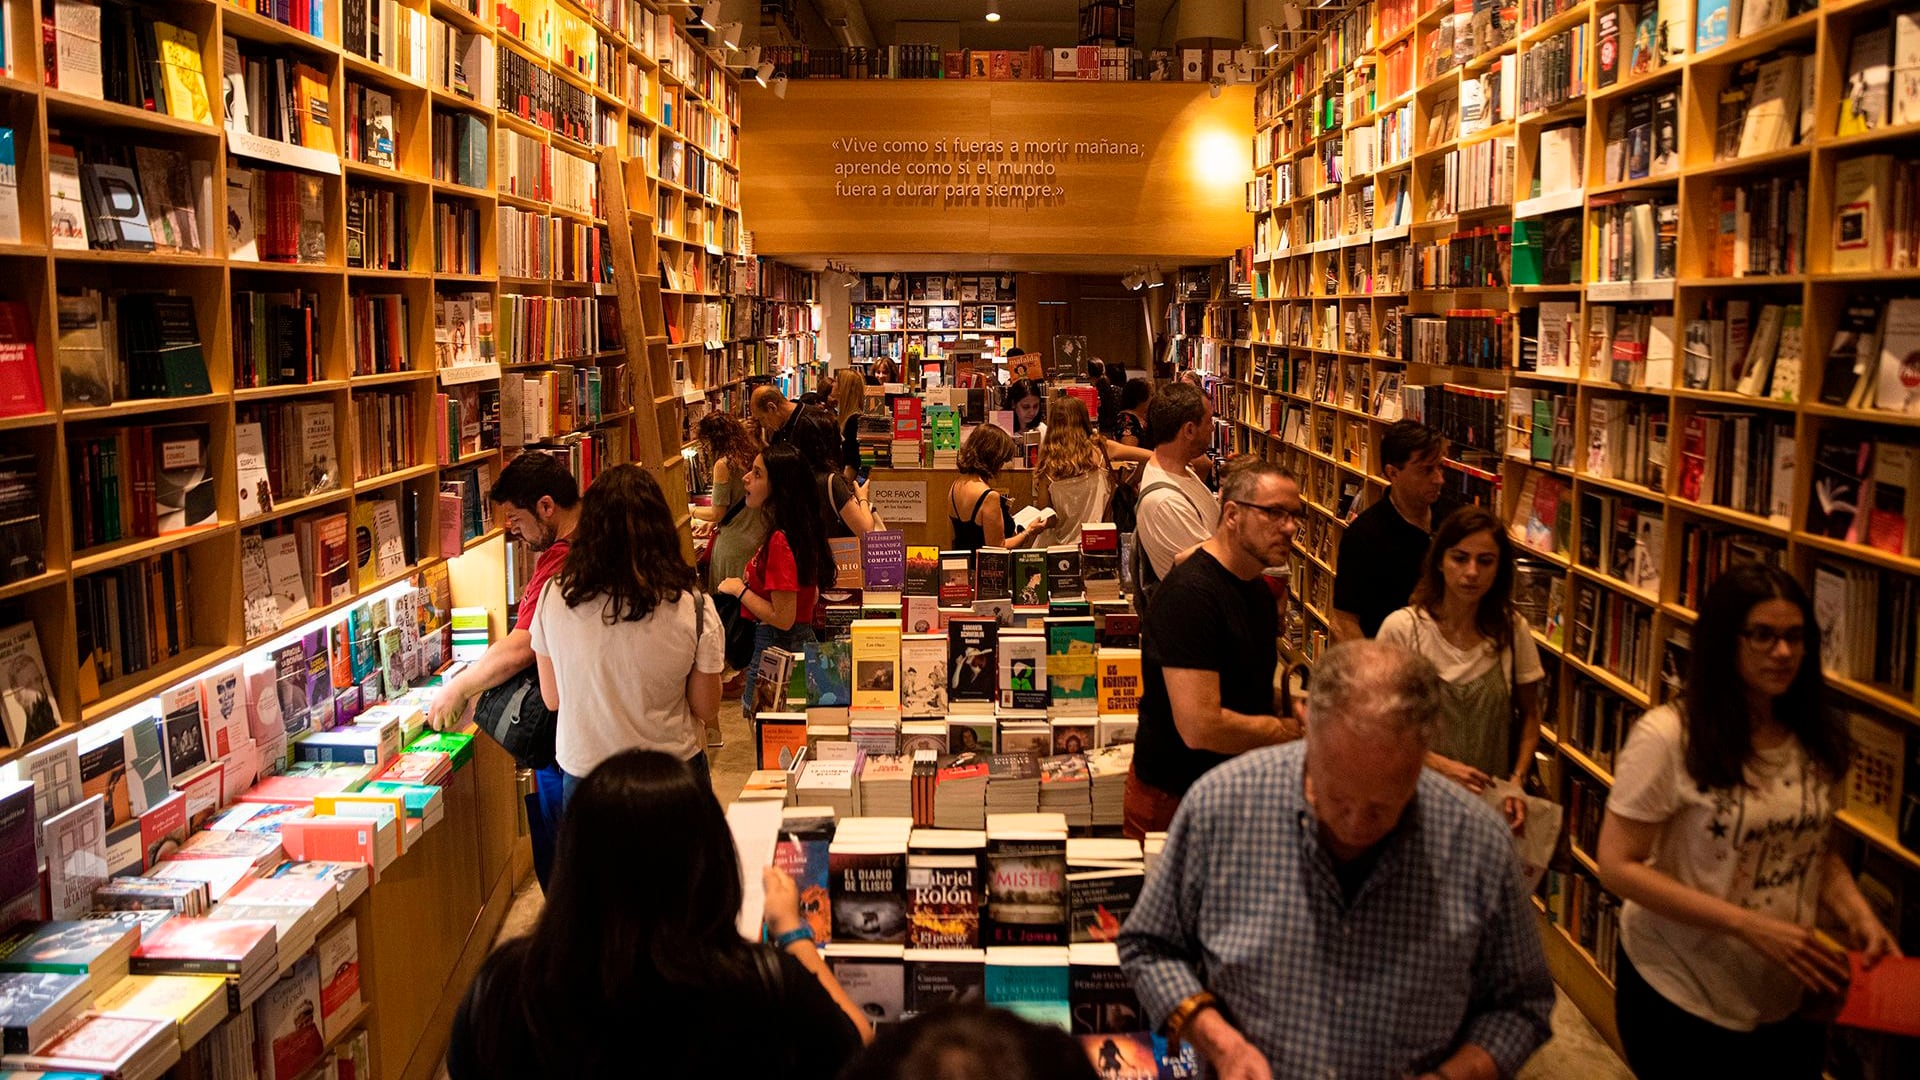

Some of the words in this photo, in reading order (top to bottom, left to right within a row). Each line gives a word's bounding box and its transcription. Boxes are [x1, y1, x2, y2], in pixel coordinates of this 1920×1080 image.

[832, 138, 877, 152] «Vive
[883, 141, 928, 153] como
[934, 138, 947, 153] si
[952, 137, 1004, 153] fueras
[1010, 141, 1019, 153] a
[1024, 138, 1069, 153] morir
[1075, 139, 1145, 157] mañana;
[834, 160, 900, 178] aprende
[906, 163, 952, 175] como
[958, 160, 969, 175] si
[977, 160, 990, 175] el
[998, 160, 1055, 176] mundo
[835, 181, 876, 197] fuera
[882, 185, 891, 197] a
[896, 181, 939, 197] durar
[945, 185, 980, 200] para
[986, 181, 1064, 200] siempre.»
[875, 490, 892, 498] POR
[894, 490, 920, 498] FAVOR
[836, 563, 859, 571] ARIO
[844, 869, 855, 880] EL
[858, 869, 893, 880] DIARIO
[994, 871, 1059, 887] MISTER
[845, 881, 857, 892] DE
[860, 881, 893, 892] ELISEO
[915, 886, 972, 905] Rolón
[920, 931, 931, 943] El
[933, 933, 968, 945] precio
[1021, 930, 1057, 942] James
